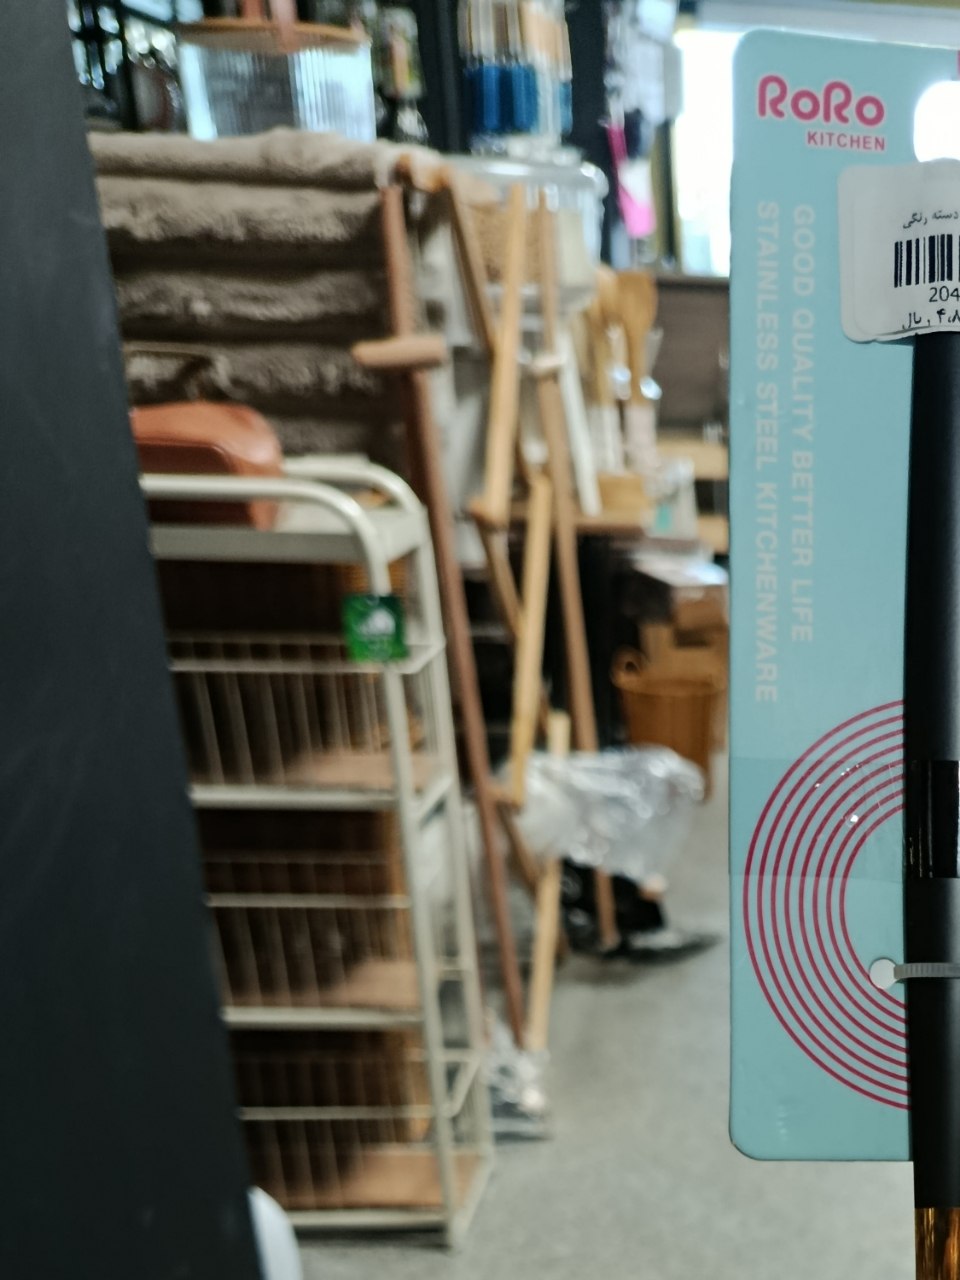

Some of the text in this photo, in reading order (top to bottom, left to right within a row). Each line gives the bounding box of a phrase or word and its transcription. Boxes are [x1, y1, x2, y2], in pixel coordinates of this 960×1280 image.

[757, 74, 886, 127] RoRo
[806, 130, 886, 151] KITCHEN
[902, 211, 928, 229] رنگی
[931, 210, 959, 220] دسته
[791, 204, 816, 642] GOOD QUALITY BETTER LIFE
[755, 201, 780, 703] STAINLESS STEEL KITCHENWARE
